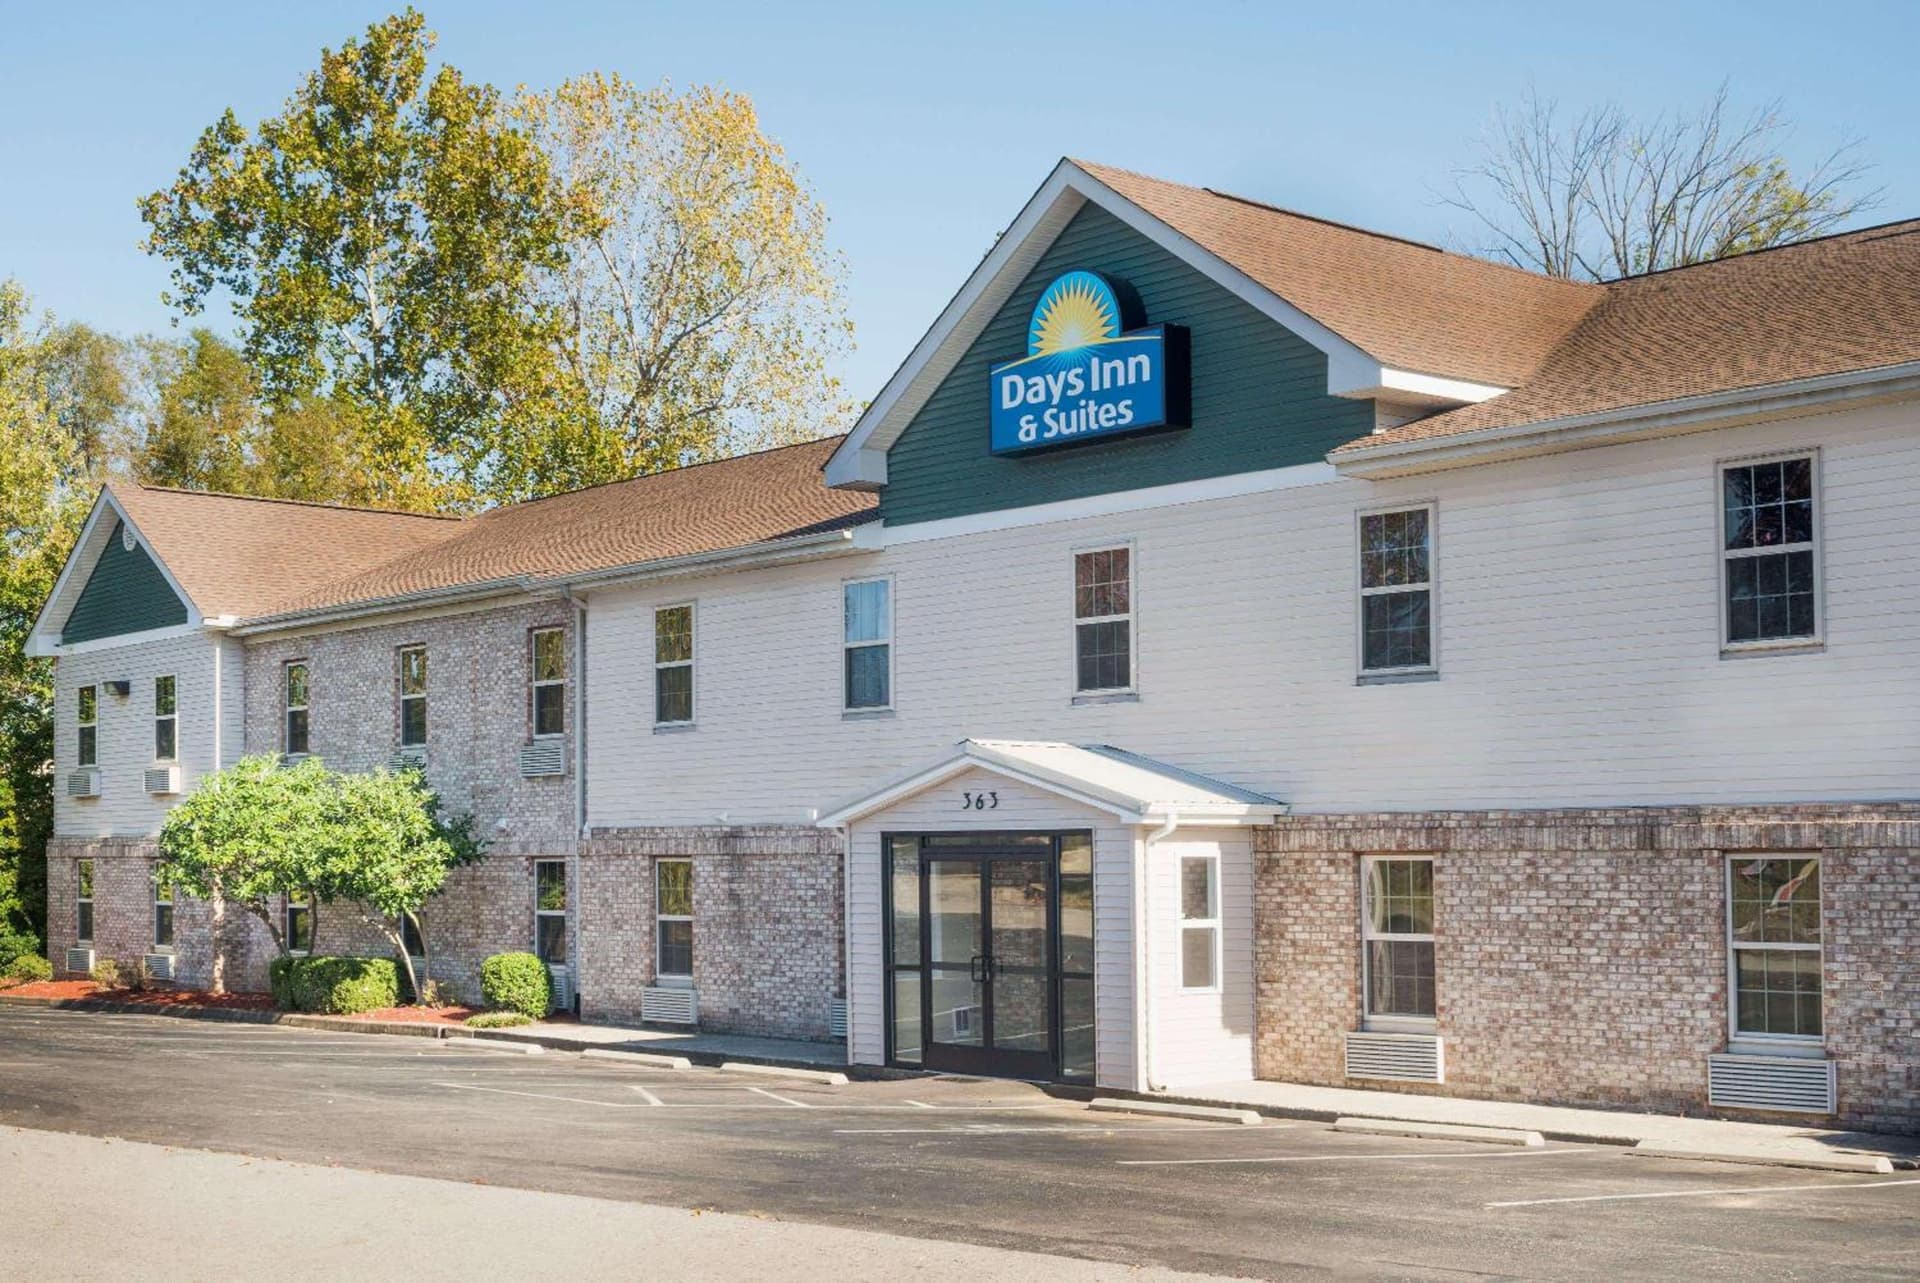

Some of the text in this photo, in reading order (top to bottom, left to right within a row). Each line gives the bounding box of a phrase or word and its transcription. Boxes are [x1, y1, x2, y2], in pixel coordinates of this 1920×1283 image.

[1002, 353, 1150, 410] Days Inn
[1018, 399, 1133, 442] & Suites
[962, 791, 998, 810] 363
